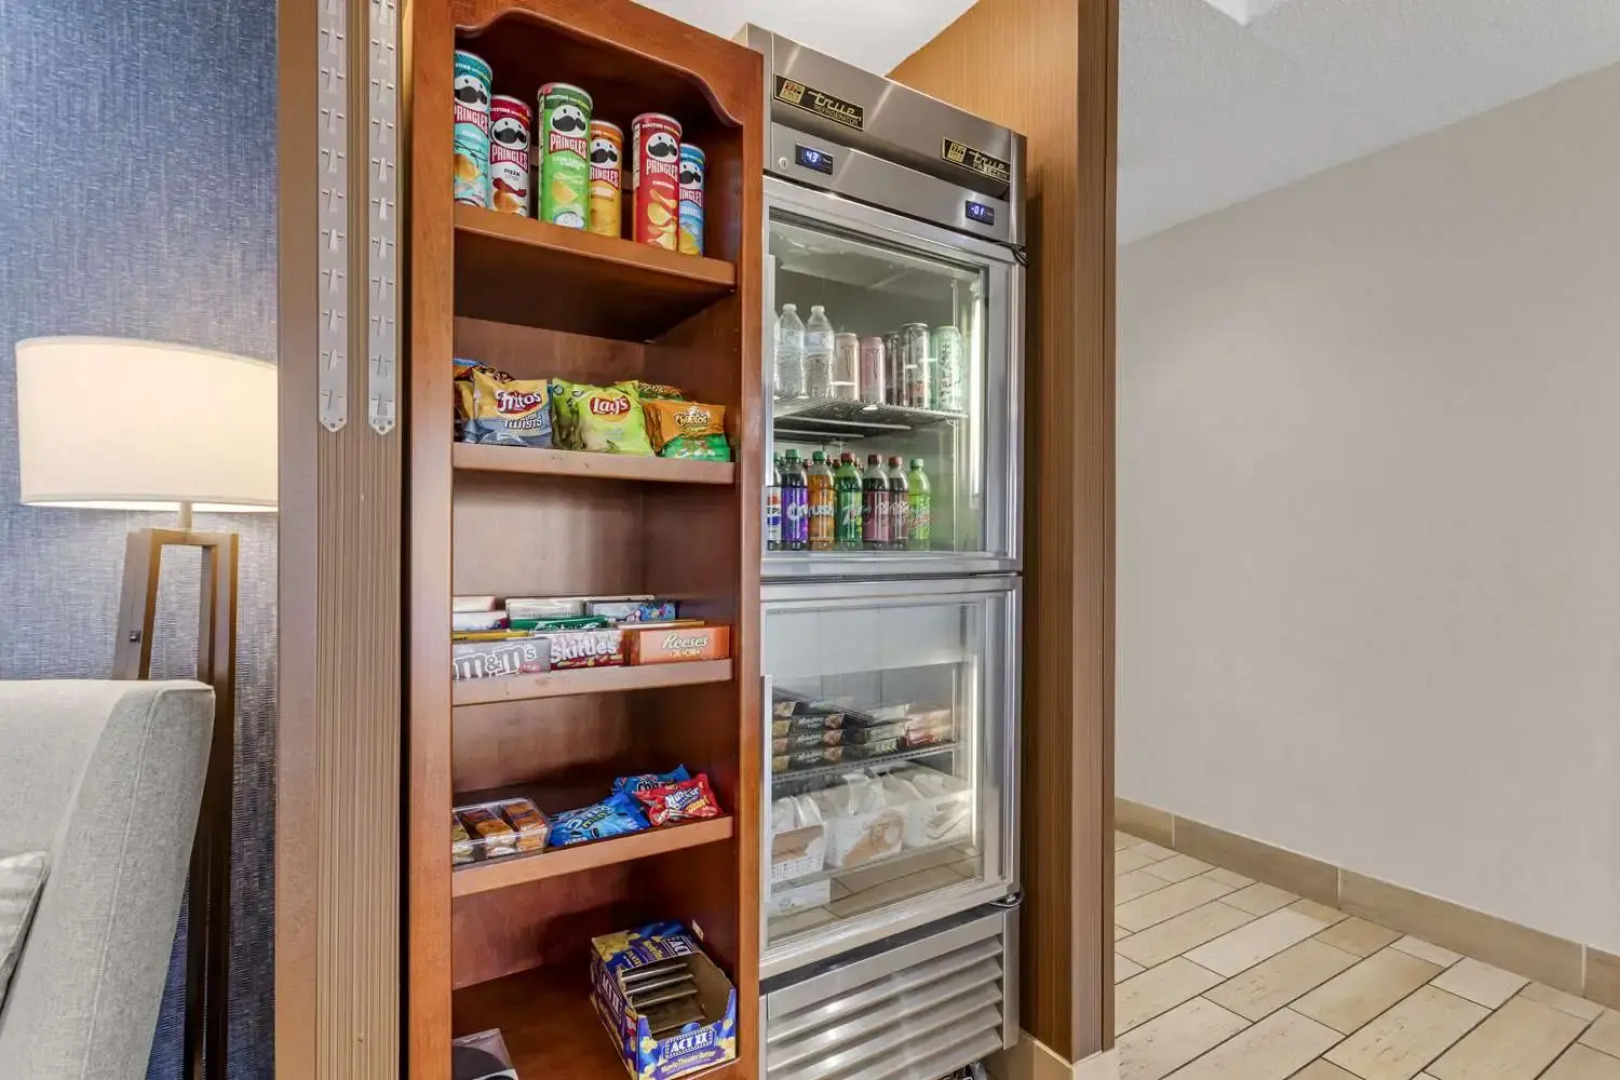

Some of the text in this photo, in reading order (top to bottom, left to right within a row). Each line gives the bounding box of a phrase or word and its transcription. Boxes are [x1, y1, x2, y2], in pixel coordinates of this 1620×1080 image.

[454, 103, 489, 138] RINGLES
[491, 143, 528, 172] PRINGLES
[550, 132, 587, 160] PRINGLES
[590, 164, 620, 190] RINGLES
[646, 158, 678, 182] PRINGLES
[680, 188, 704, 208] INGLES
[495, 390, 541, 412] Fritos
[550, 635, 618, 662] Skittles
[670, 1037, 694, 1053] ACT
